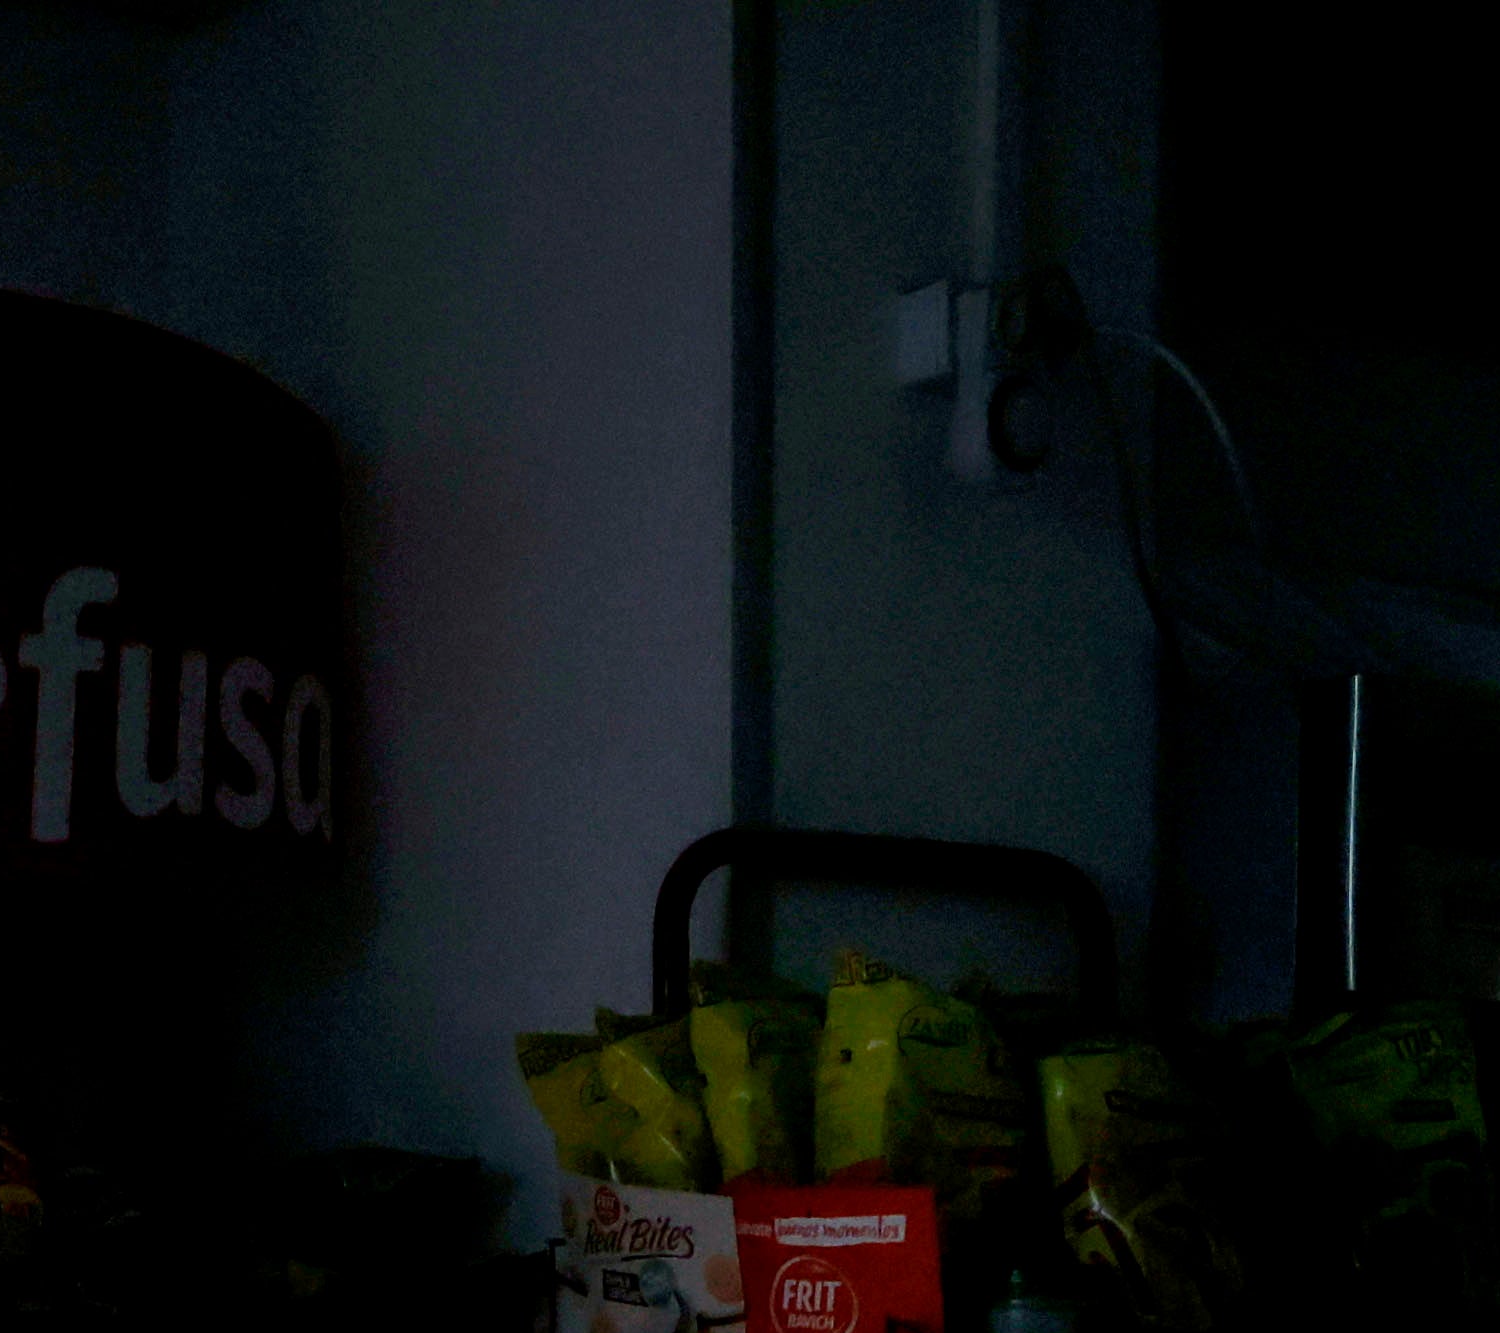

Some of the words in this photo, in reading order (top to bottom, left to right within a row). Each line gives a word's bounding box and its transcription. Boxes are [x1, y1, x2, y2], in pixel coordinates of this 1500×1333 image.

[628, 1214, 694, 1257] Bites
[783, 1279, 842, 1312] FRIT
[787, 1312, 834, 1330] RAVICH
